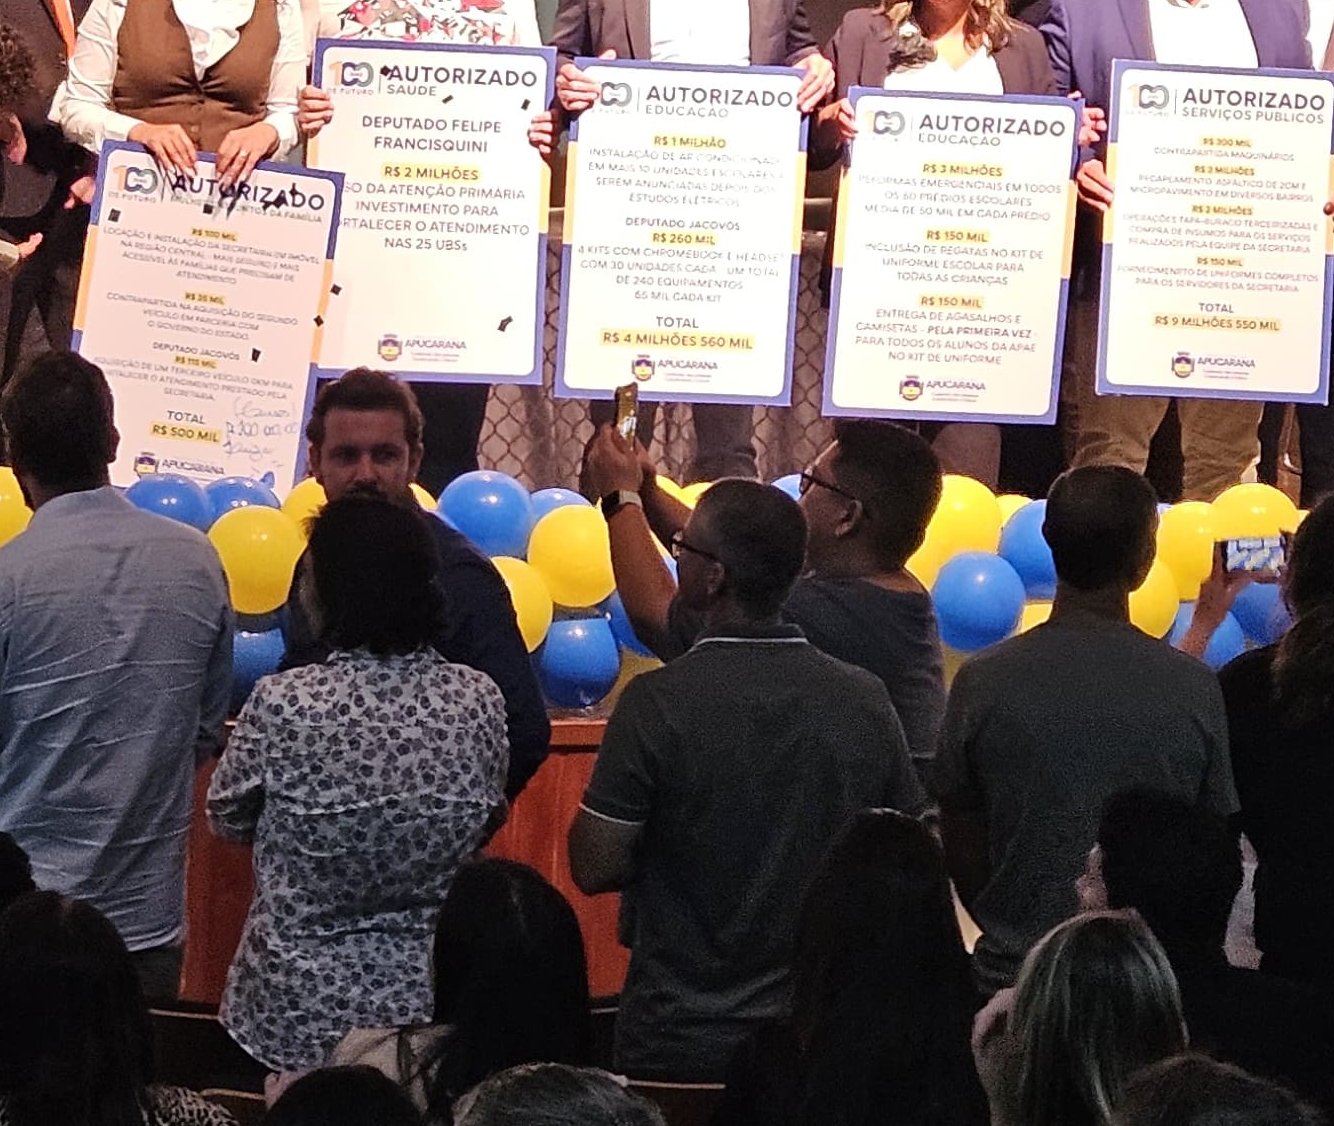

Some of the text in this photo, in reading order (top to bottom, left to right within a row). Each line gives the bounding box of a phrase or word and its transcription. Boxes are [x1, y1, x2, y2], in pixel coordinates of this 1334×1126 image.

[386, 64, 538, 88] AUTORIZADO
[645, 85, 793, 108] AUTORIZADO
[1182, 87, 1325, 112] AUTORIZADO
[362, 114, 502, 134] DEPUTADO FELIPE
[918, 114, 1066, 138] AUTORIZADO
[374, 135, 488, 153] FRANCISQUINI
[384, 165, 401, 178] R$
[416, 165, 479, 181] MILHÕES
[366, 182, 387, 195] DA
[388, 183, 456, 199] ATENÇÃO
[355, 200, 499, 217] INVESTIMENTO PARA
[340, 217, 412, 231] RTALECER
[428, 220, 530, 236] ATENDIMENTO
[384, 237, 413, 249] NAS
[415, 237, 432, 250] 25
[1198, 302, 1235, 314] TOTAL
[655, 315, 700, 329] TOTAL
[166, 409, 206, 425] TOTAL
